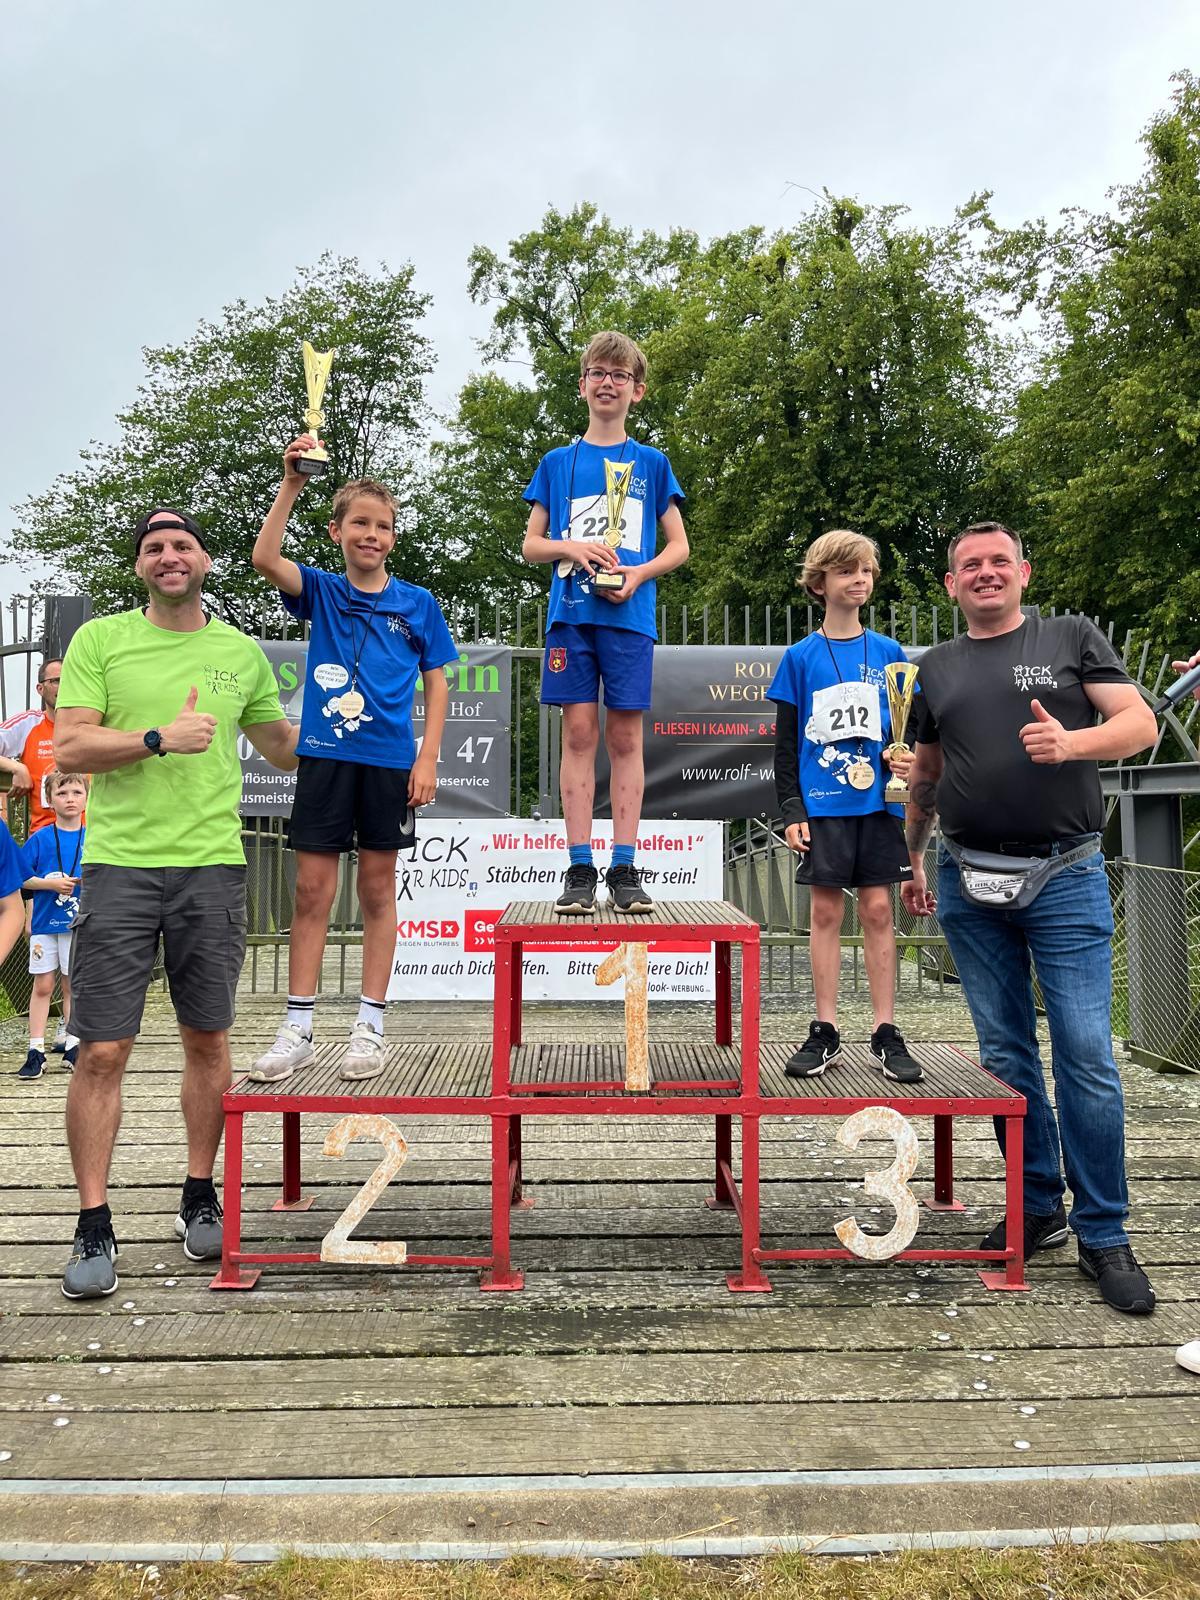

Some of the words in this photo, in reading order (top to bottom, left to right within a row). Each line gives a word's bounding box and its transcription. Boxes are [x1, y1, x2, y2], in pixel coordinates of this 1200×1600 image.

[450, 701, 484, 717] Hof
[829, 704, 869, 731] 212
[654, 722, 700, 735] FLIESEN
[709, 723, 755, 735] KAMIN-
[456, 736, 495, 764] 47
[524, 834, 570, 851] helfe
[429, 869, 469, 889] KIDS
[486, 866, 556, 883] Stäbchen
[661, 868, 698, 884] sein!
[394, 960, 428, 975] kann
[431, 961, 464, 975] auch
[467, 961, 496, 975] Dich
[567, 961, 599, 975] Bitte
[675, 961, 709, 975] Dich!
[671, 985, 705, 993] WERBUNG
[594, 942, 649, 1092] 1
[321, 1113, 409, 1265] 2
[833, 1106, 920, 1261] 3
